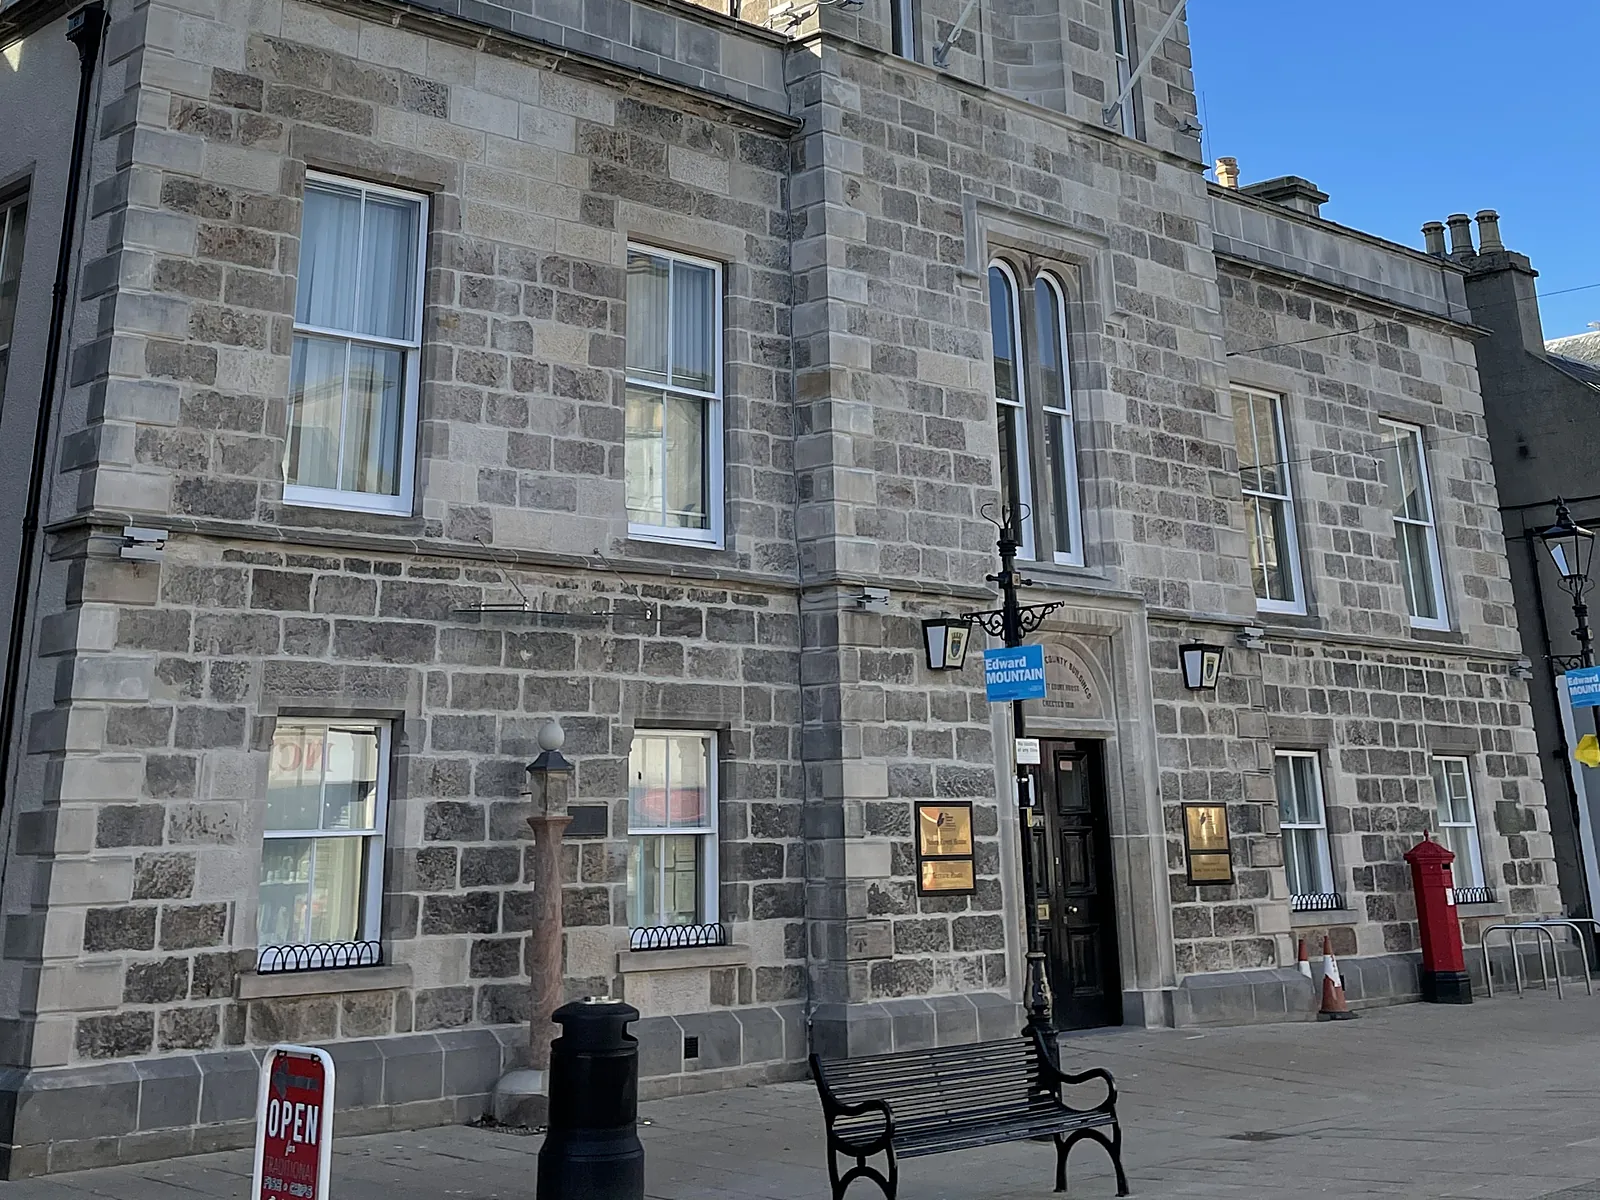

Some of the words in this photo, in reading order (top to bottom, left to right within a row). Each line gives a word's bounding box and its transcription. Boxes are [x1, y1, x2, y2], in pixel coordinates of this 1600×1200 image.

[985, 656, 1026, 670] Edward
[986, 668, 1043, 684] MOUNTAIN
[1044, 655, 1067, 667] COUNTY
[1069, 663, 1092, 699] BUILDINGS
[1567, 674, 1599, 685] Edward
[268, 1099, 319, 1145] OPEN
[265, 1156, 314, 1182] TRADITIONAL
